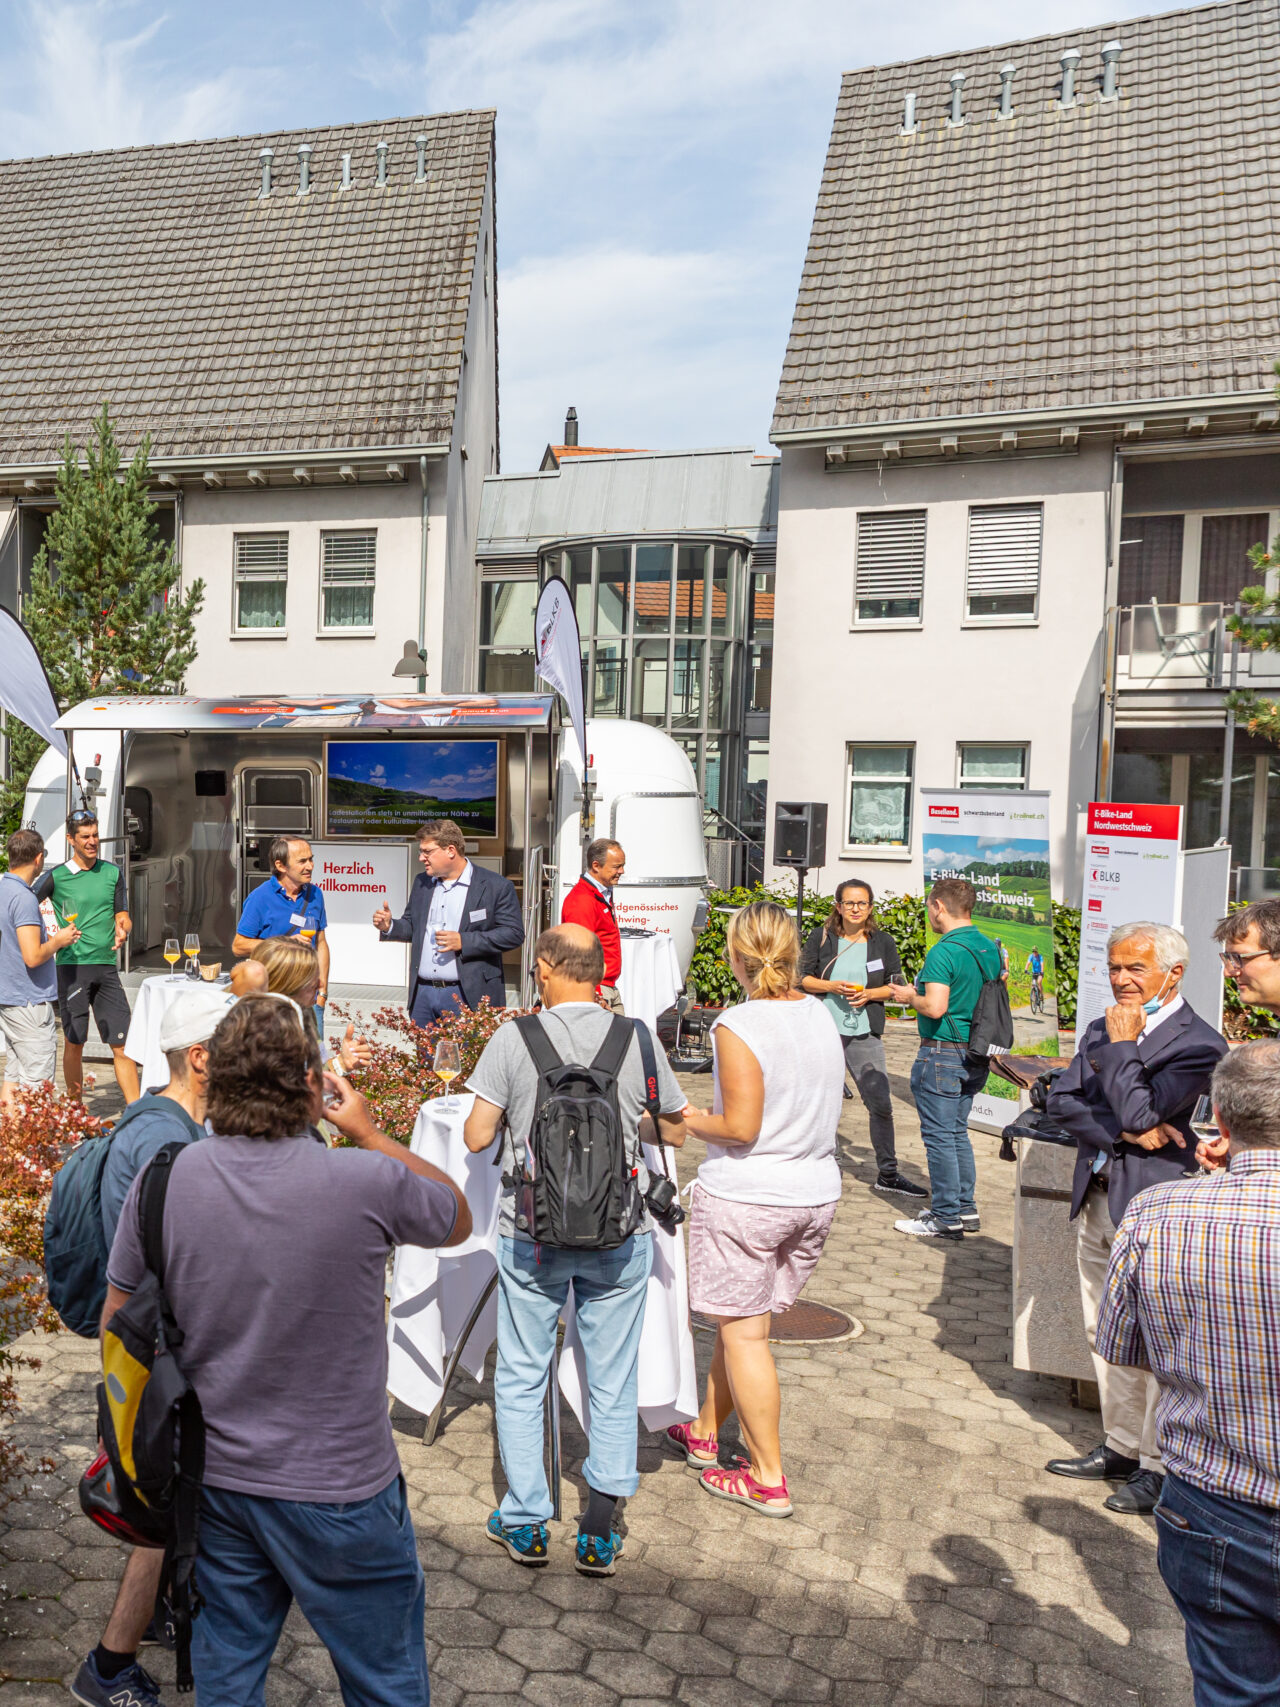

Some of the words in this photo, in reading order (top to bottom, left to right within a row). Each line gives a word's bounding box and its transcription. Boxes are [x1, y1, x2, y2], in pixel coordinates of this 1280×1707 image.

[329, 809, 376, 817] Ladestationen
[402, 810, 449, 818] unmittelbarer
[450, 810, 470, 818] Nähe
[1094, 809, 1133, 820] E-Bike-Land
[329, 817, 365, 825] Restaurant
[365, 817, 382, 825] oder
[1093, 821, 1153, 833] Nordwestschweiz
[323, 860, 375, 876] Herzlich
[930, 868, 1000, 887] E-Bike-Land
[1100, 870, 1121, 883] BLKB
